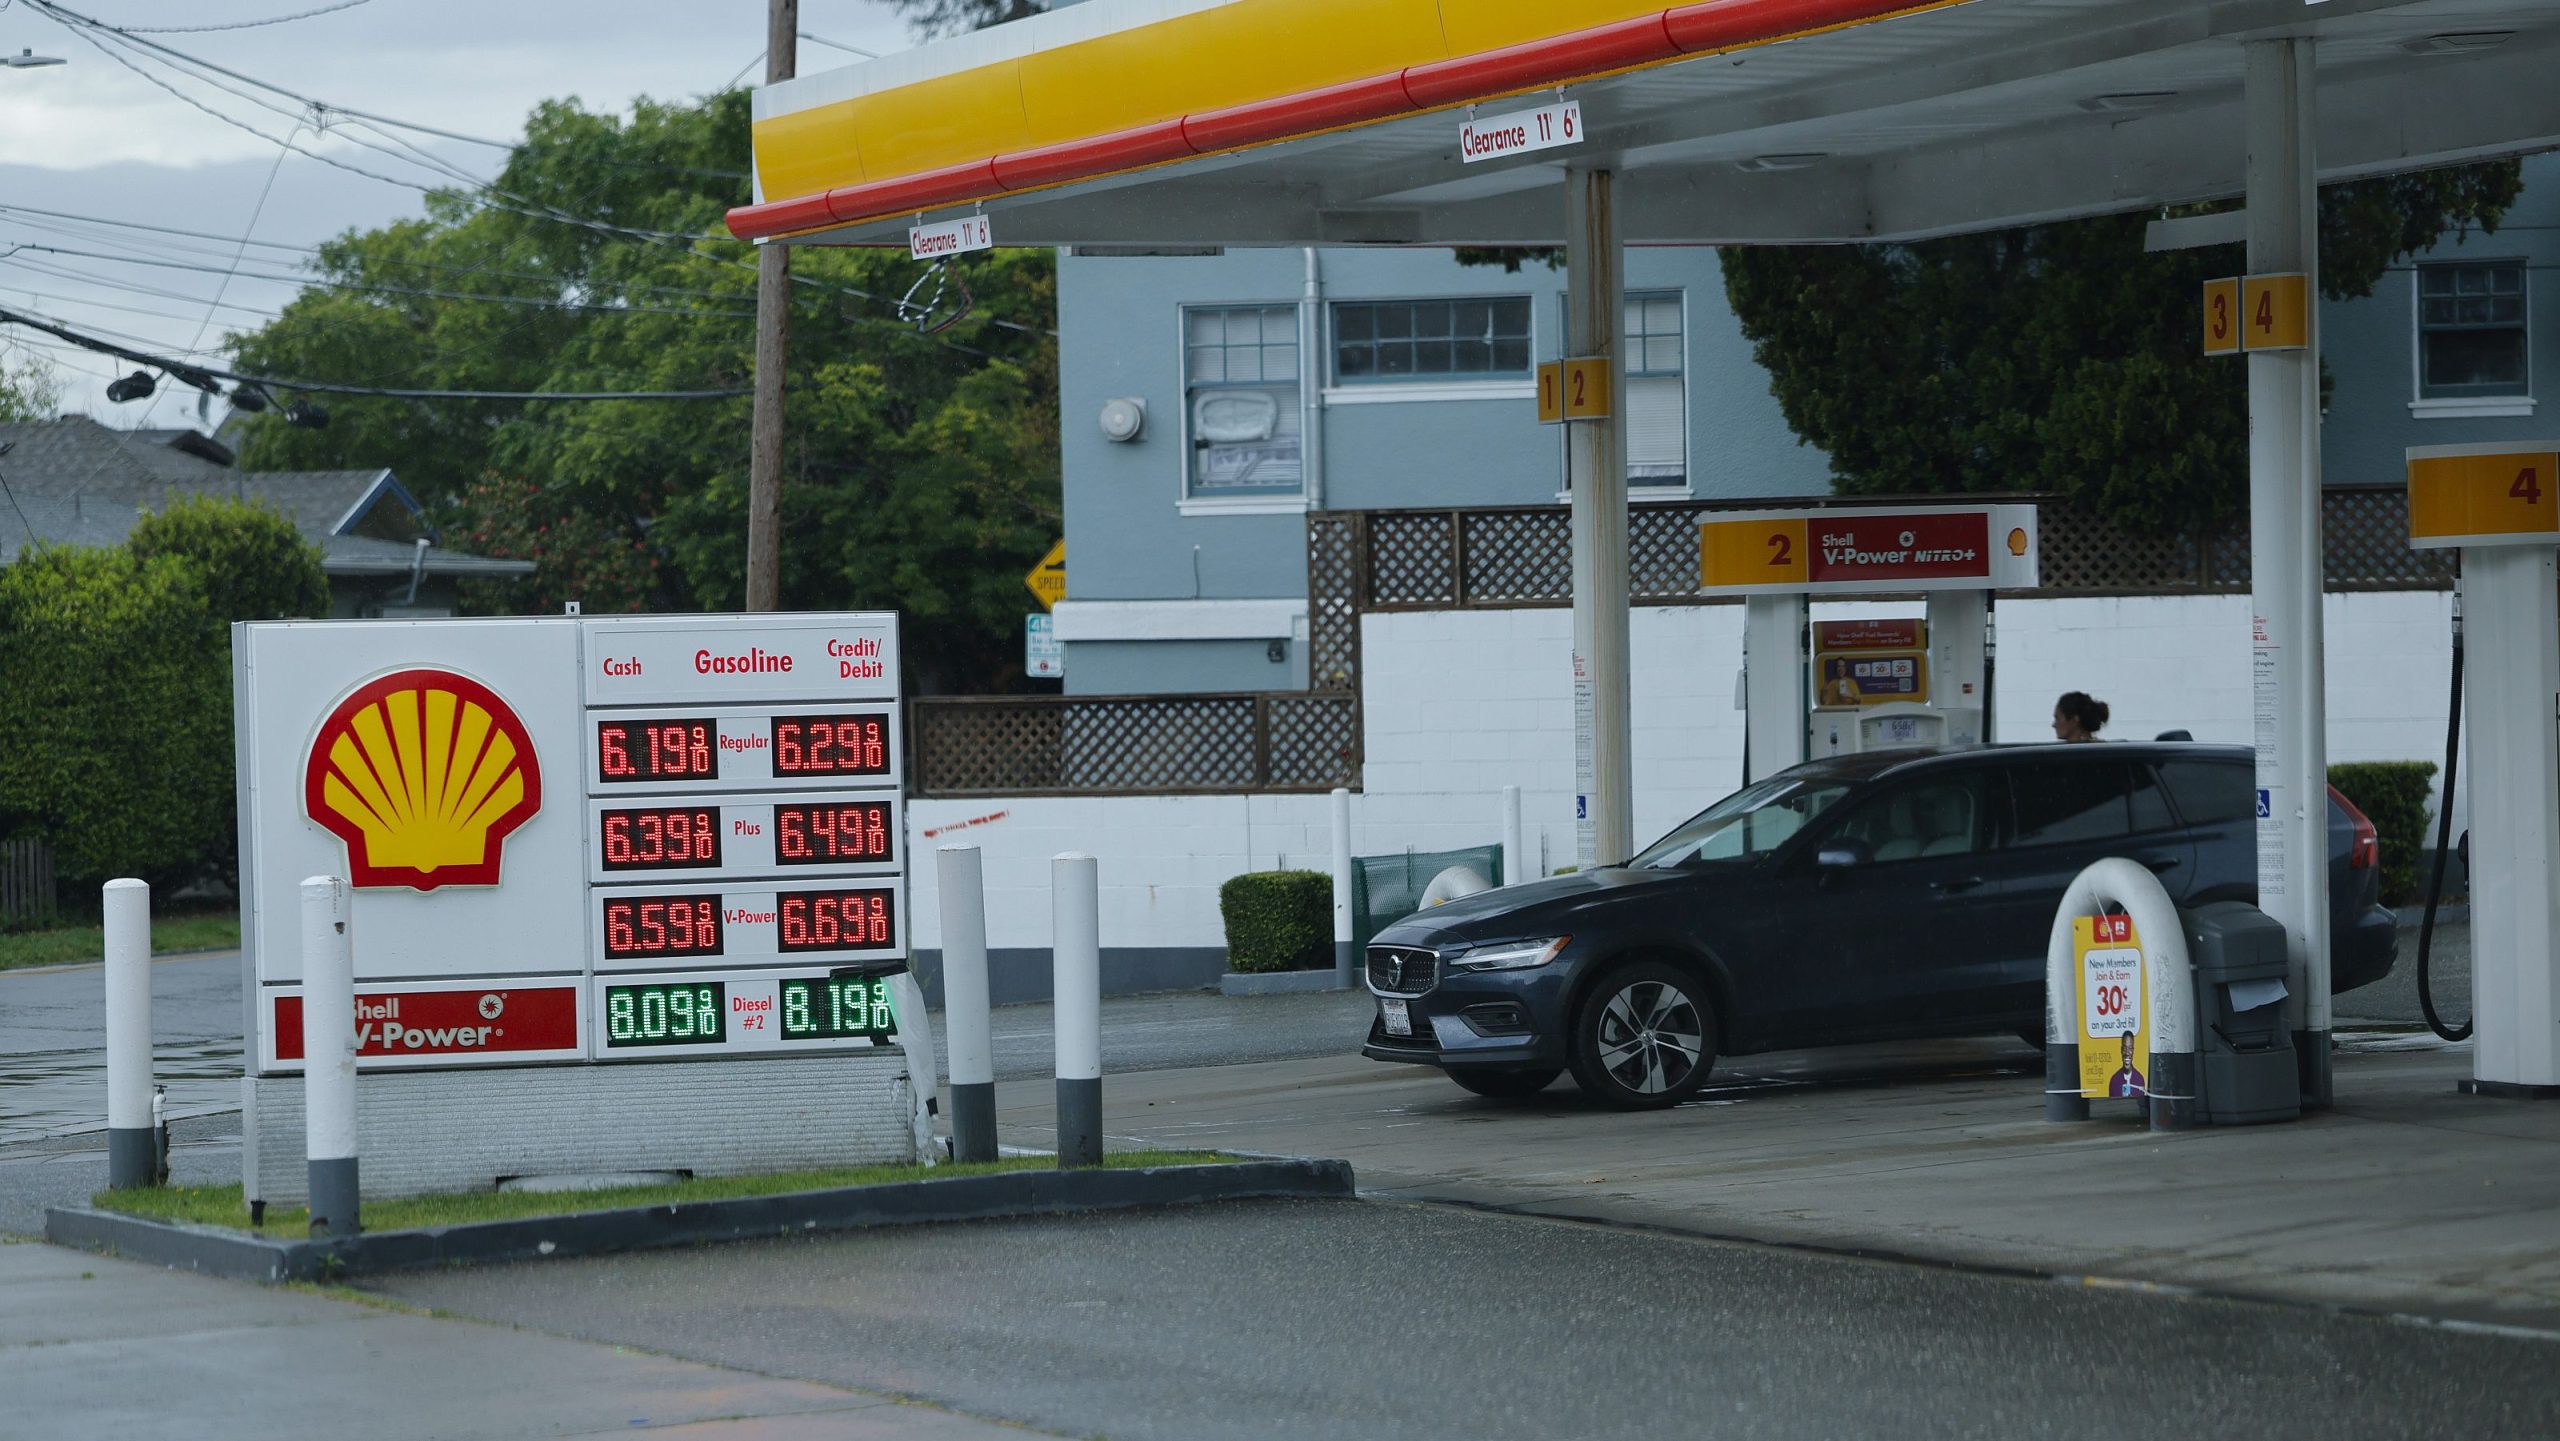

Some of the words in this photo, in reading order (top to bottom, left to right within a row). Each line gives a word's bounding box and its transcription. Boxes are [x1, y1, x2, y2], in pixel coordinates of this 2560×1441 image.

[1463, 125, 1525, 156] Clearance
[912, 230, 957, 255] Clearance
[2213, 293, 2227, 340] 3
[2256, 290, 2273, 334] 4
[1545, 374, 1552, 410] 1
[1573, 369, 1584, 406] 2
[2509, 467, 2542, 505] 4
[1767, 534, 1792, 566] 2
[1822, 533, 1854, 547] Shell
[1823, 548, 1907, 566] V-Power
[1038, 576, 1066, 590] SPEED
[694, 647, 793, 675] Gasoline
[827, 638, 882, 658] Credit/
[603, 656, 642, 676] Cash
[839, 659, 883, 679] Debit
[602, 726, 687, 775] 6.19
[719, 732, 769, 754] Regular
[778, 722, 860, 770] 6.29
[605, 814, 690, 862] 6.39
[734, 820, 761, 836] Plus
[781, 810, 863, 857] 6.49
[608, 903, 693, 951] 6.59
[723, 910, 777, 925] V-Power
[783, 897, 866, 944] 6.69
[2089, 959, 2105, 969] New
[2107, 957, 2137, 969] Members
[2095, 971, 2108, 981] Join
[2109, 971, 2114, 980] &
[2116, 970, 2131, 980] Earn
[610, 990, 695, 1039] 8.09
[733, 995, 772, 1013] Diesel
[785, 984, 868, 1032] 8.19
[743, 1014, 764, 1031] #2
[2091, 1021, 2101, 1030] on
[2101, 1020, 2115, 1032] your
[2116, 1017, 2127, 1029] 3rd
[353, 1022, 492, 1050] V-Power
